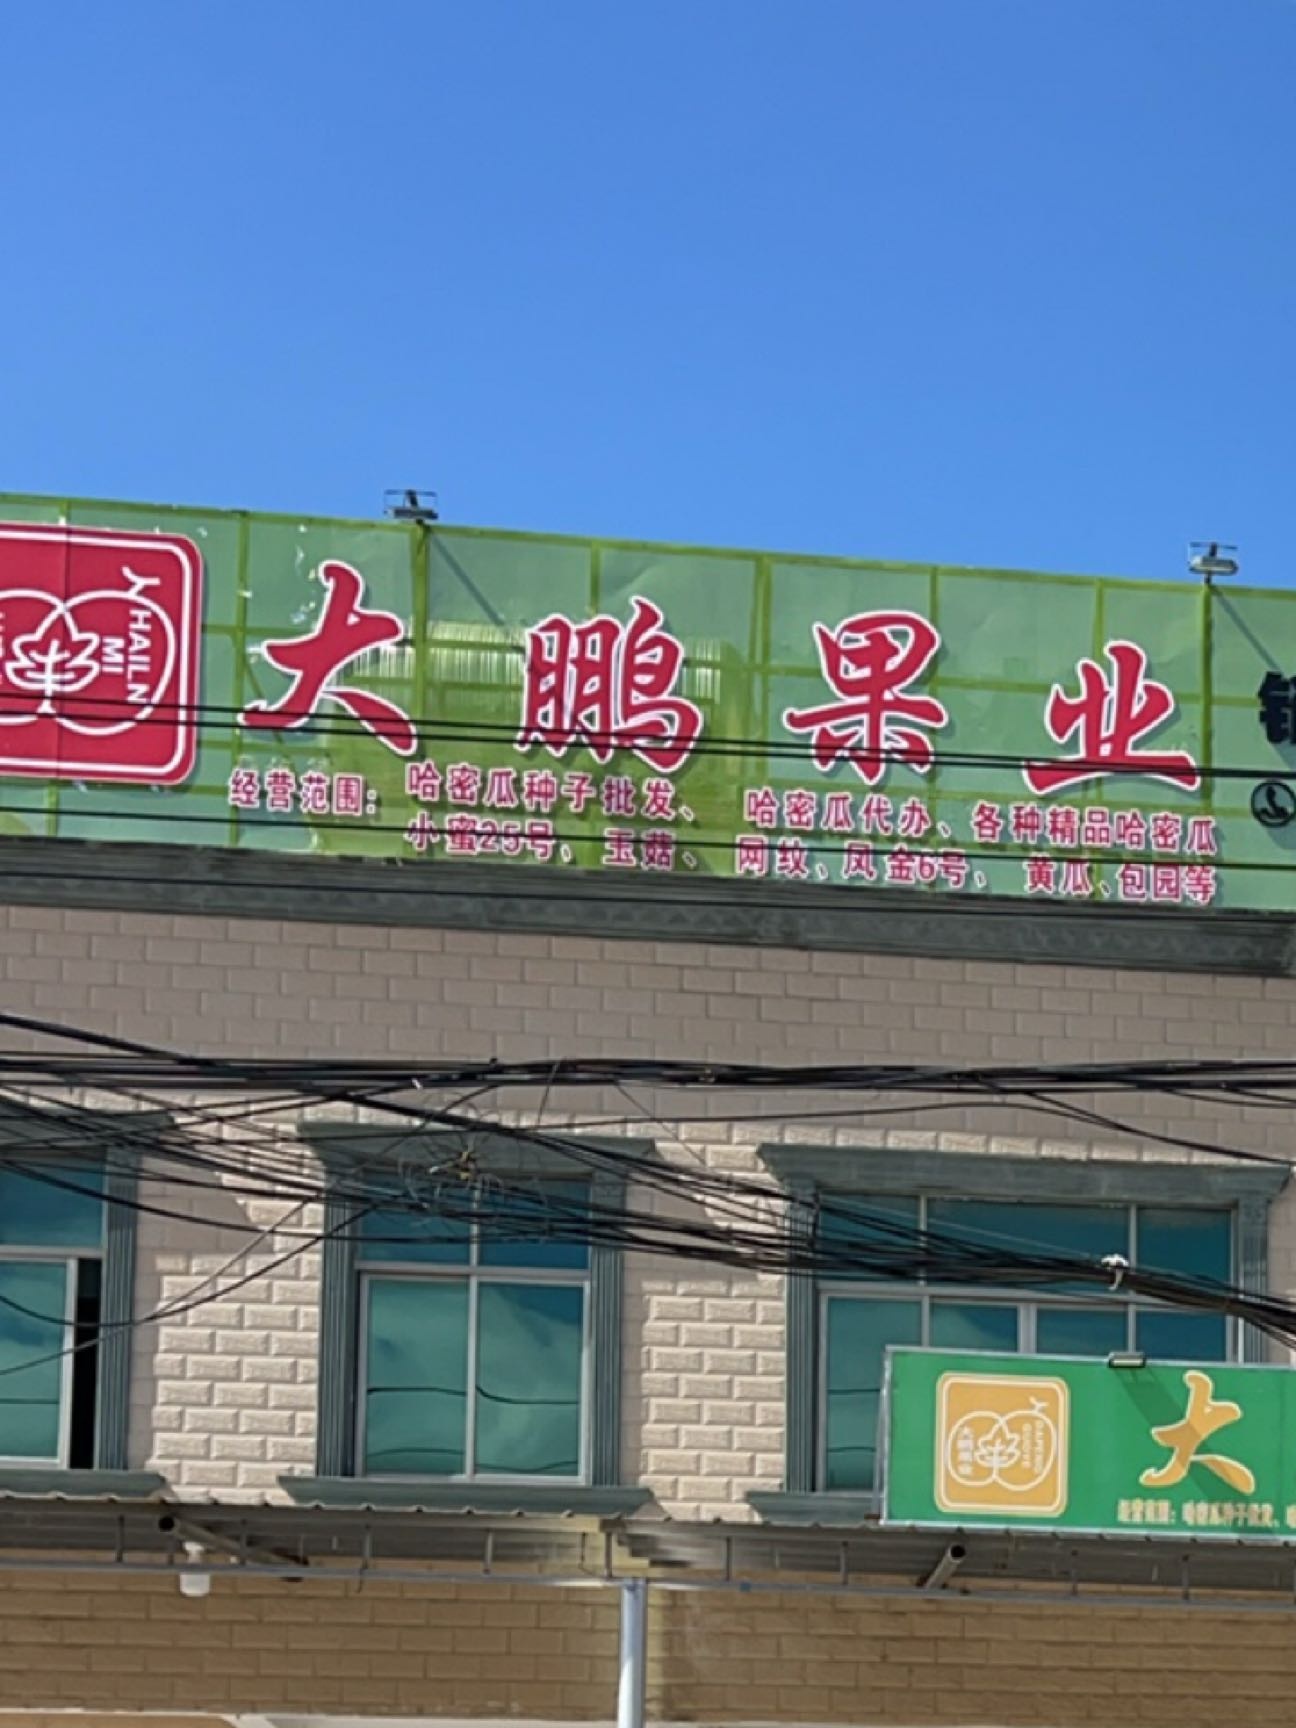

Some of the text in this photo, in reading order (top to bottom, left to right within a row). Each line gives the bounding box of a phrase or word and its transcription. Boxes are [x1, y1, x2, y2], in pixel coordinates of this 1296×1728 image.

[101, 635, 126, 674] MI
[237, 559, 1201, 795] 大鹏果业
